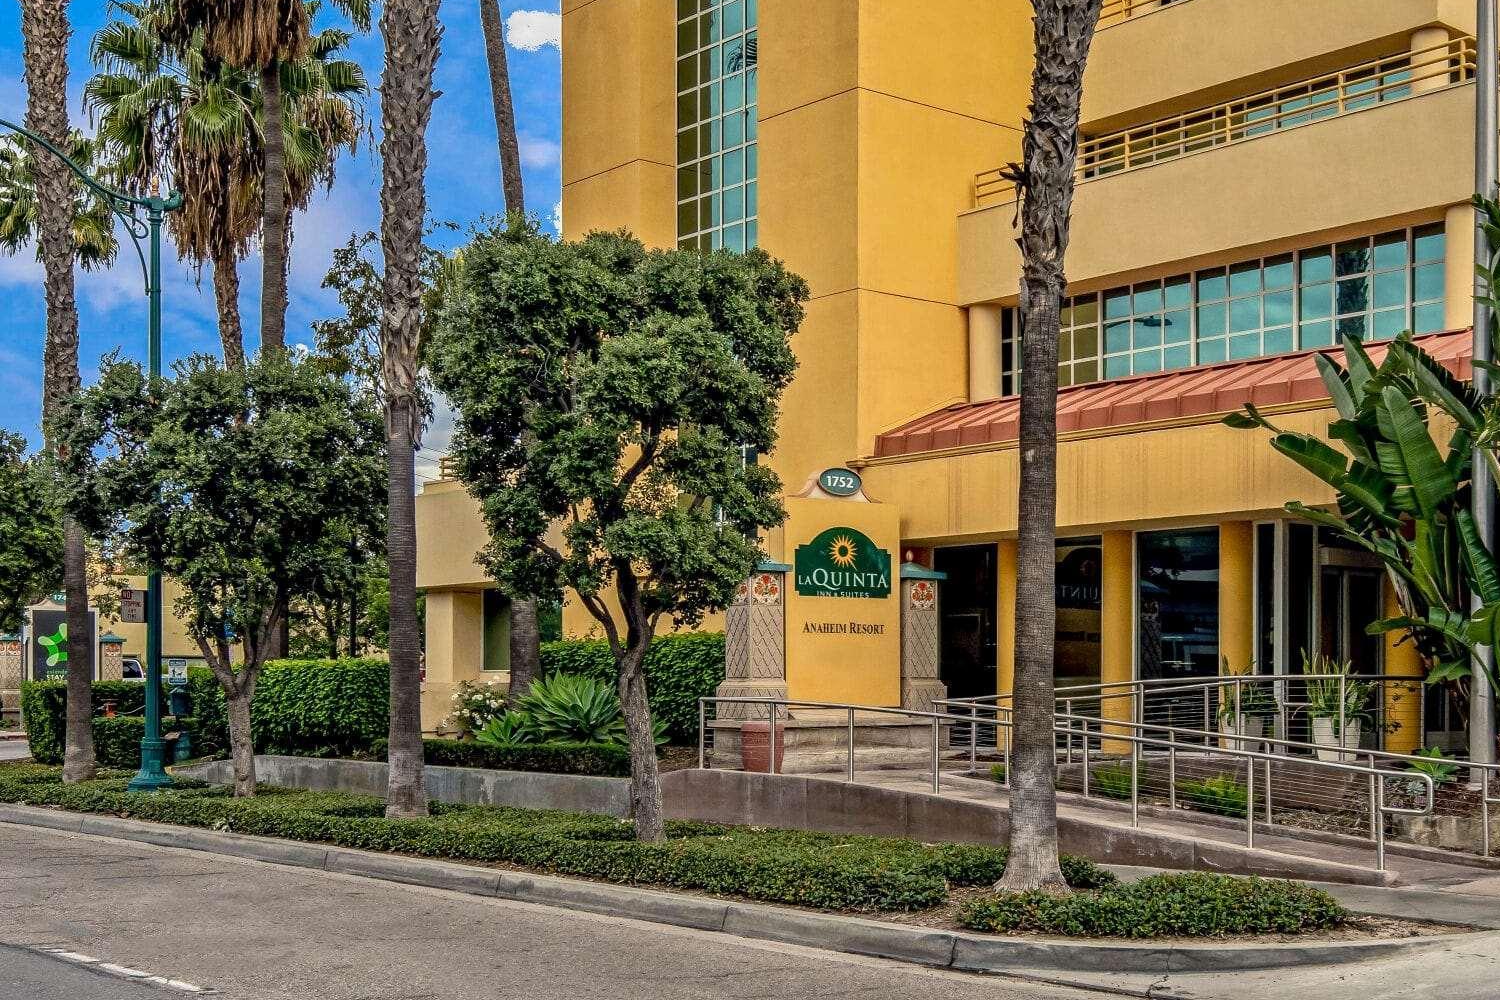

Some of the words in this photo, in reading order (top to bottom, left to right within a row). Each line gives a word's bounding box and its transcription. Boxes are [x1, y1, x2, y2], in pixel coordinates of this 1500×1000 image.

[826, 475, 854, 489] 1752
[798, 574, 812, 585] LA
[812, 567, 889, 591] QUINTA
[840, 590, 870, 599] SUITES
[802, 620, 847, 634] ANAHEIM
[849, 621, 885, 635] RESORT
